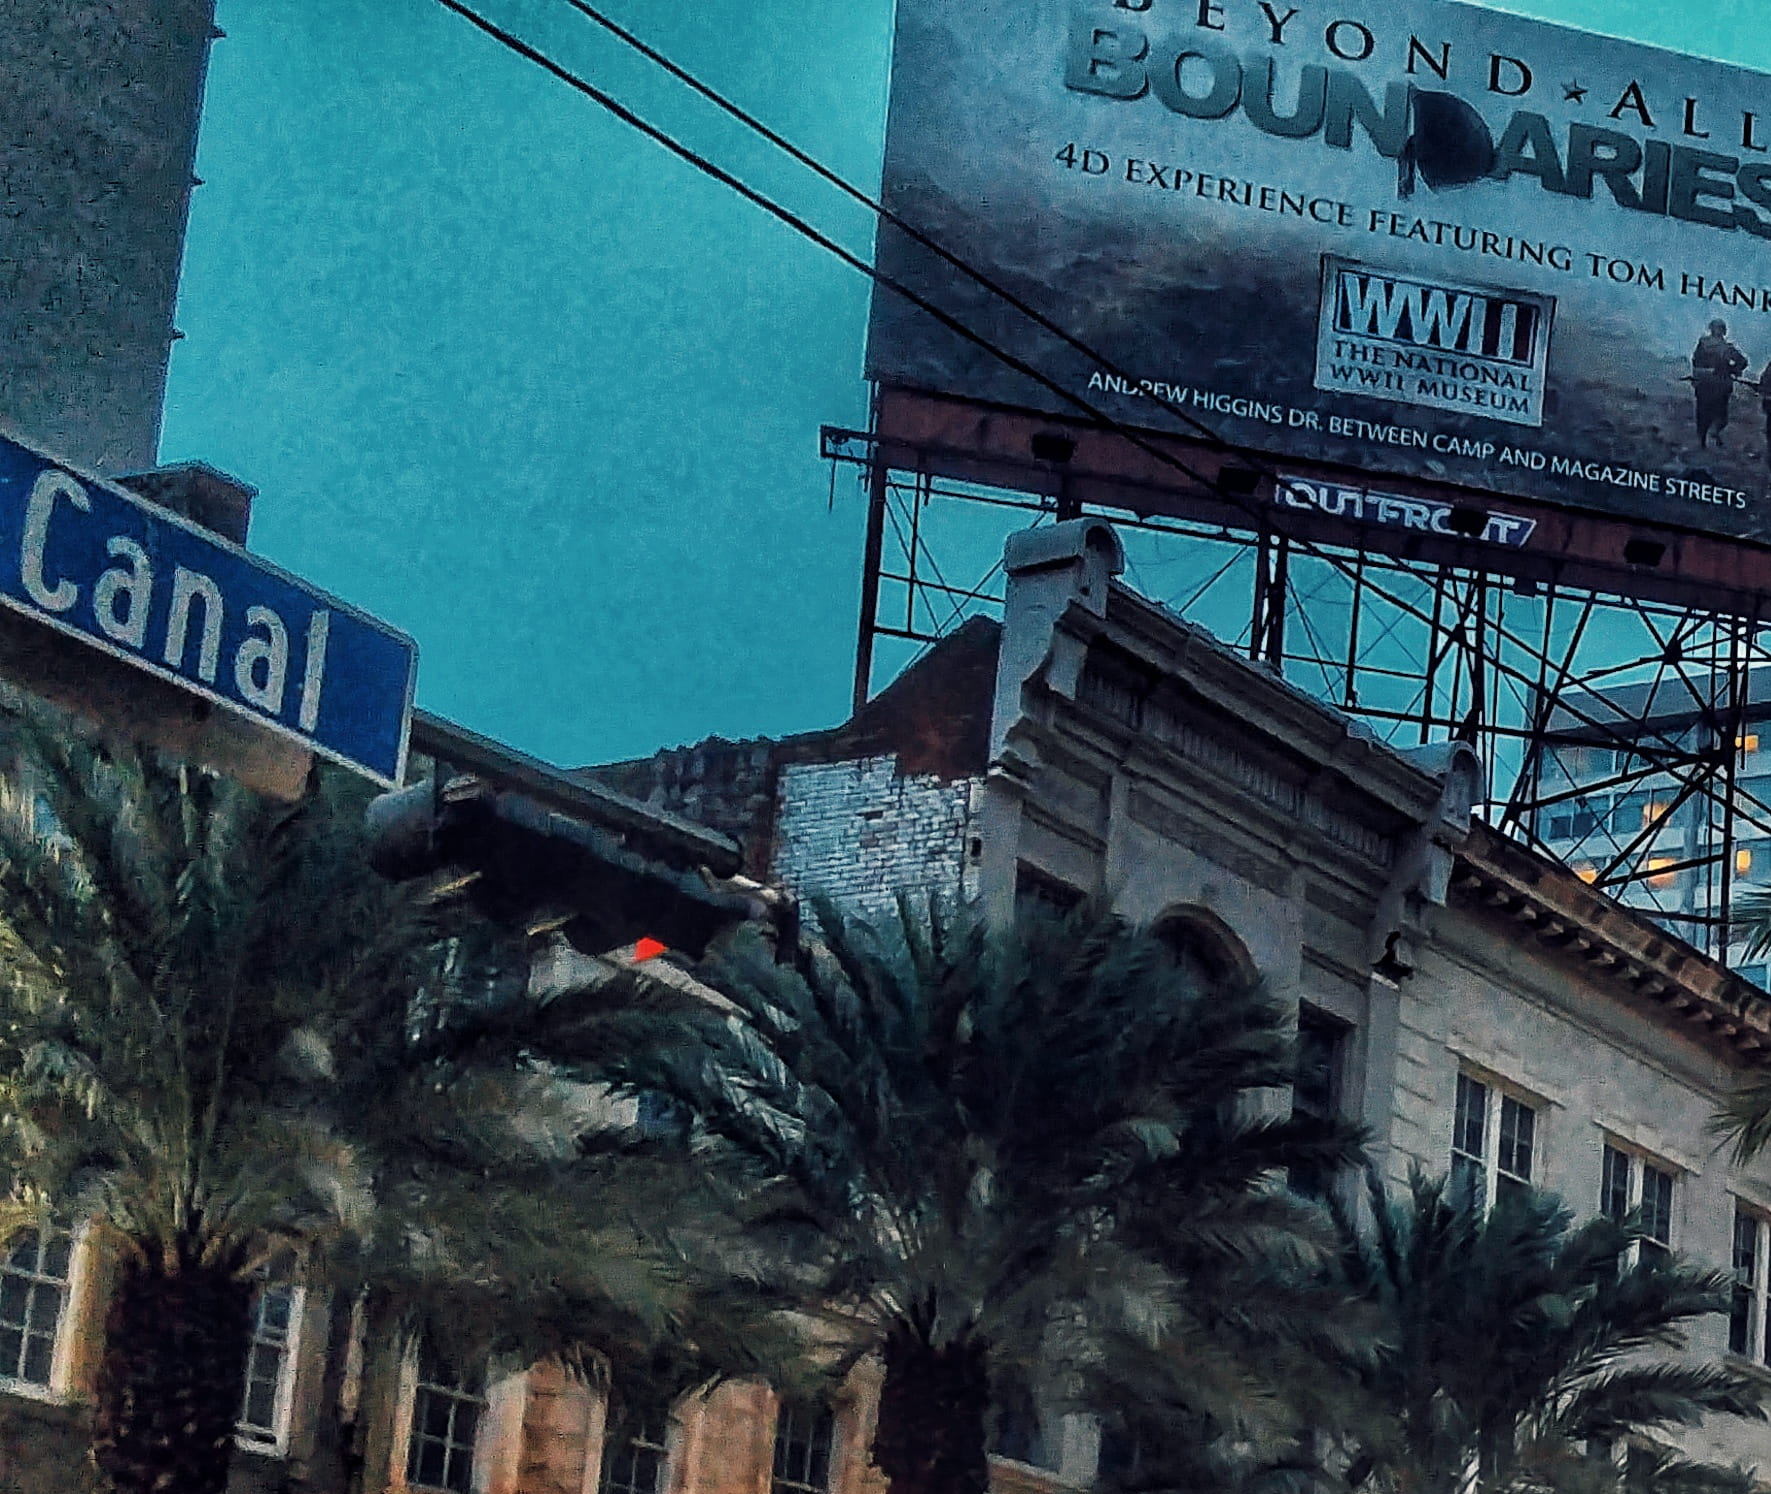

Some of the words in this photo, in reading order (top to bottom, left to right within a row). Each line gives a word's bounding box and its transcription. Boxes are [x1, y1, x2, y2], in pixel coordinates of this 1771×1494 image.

[1608, 79, 1769, 153] ALL
[1055, 143, 1111, 176] 4D
[1126, 157, 1354, 227] EXPERIENCE
[1369, 209, 1572, 272] FEATURING
[1585, 252, 1665, 291] TOM
[1341, 271, 1518, 361] WWII
[1331, 363, 1405, 391] WWII
[1416, 377, 1530, 415] MUSEUM
[1335, 340, 1385, 366] THE
[1393, 350, 1533, 393] NATIONAL
[1192, 388, 1283, 424] HIGGINS
[1288, 407, 1325, 432] DR.
[1329, 415, 1429, 448] BETWEEN
[1432, 433, 1495, 460] CAMP
[1500, 446, 1547, 472] AND
[1550, 456, 1661, 493] MAGAZINE
[1665, 477, 1748, 510] STREETS
[1285, 481, 1520, 545] OUTFROT
[20, 468, 330, 733] Canal
